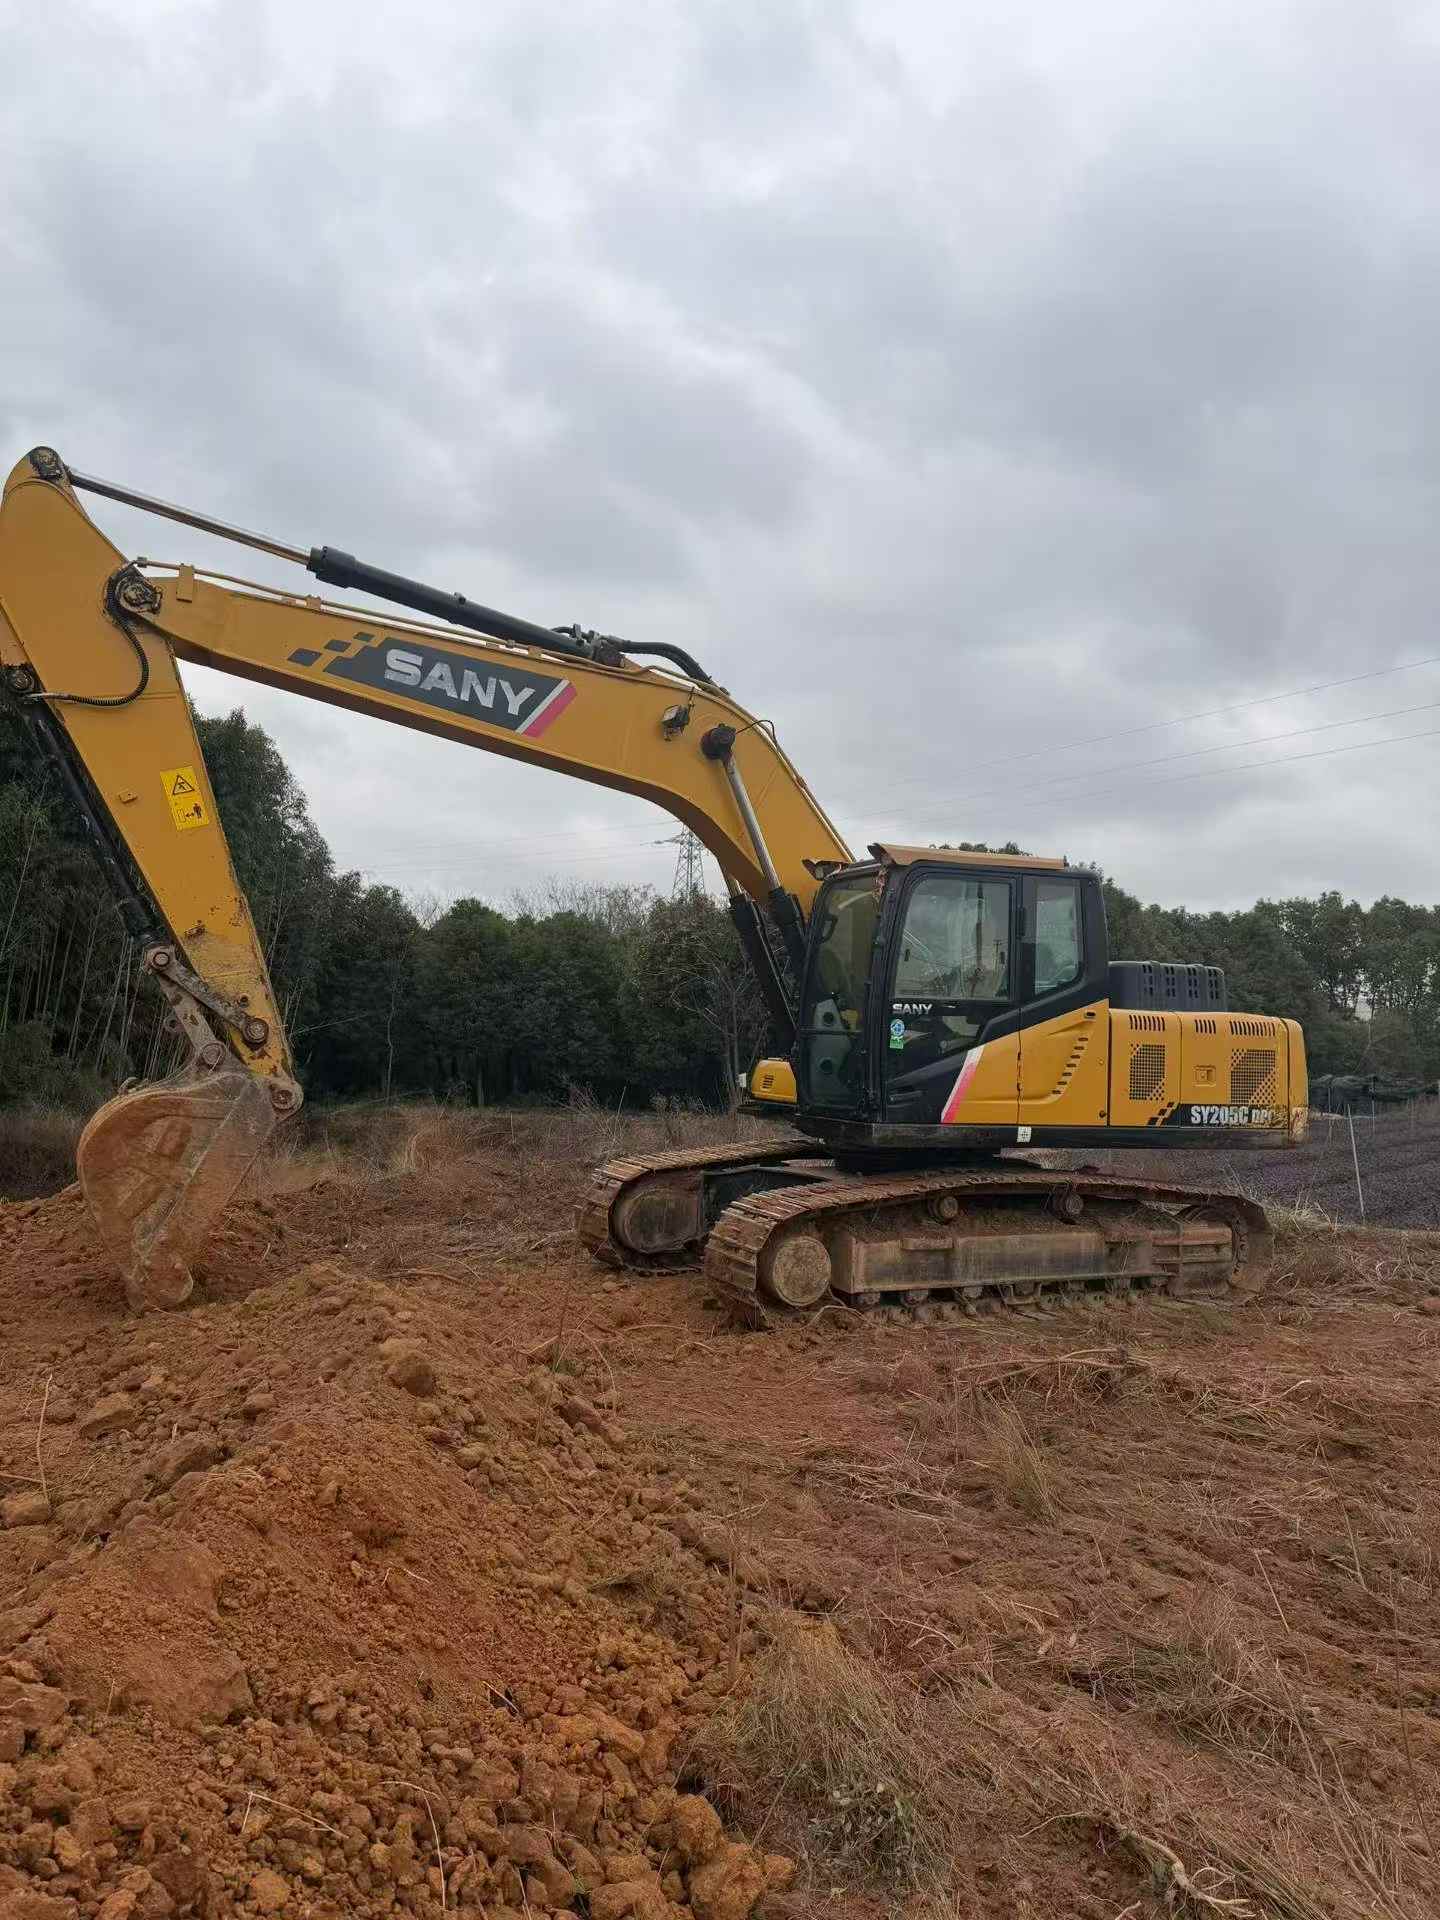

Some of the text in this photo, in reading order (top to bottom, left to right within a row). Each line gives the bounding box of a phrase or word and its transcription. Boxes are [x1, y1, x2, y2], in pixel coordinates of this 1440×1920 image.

[384, 648, 536, 716] SANY
[892, 1003, 933, 1015] SANY
[1190, 1105, 1249, 1125] SY205C
